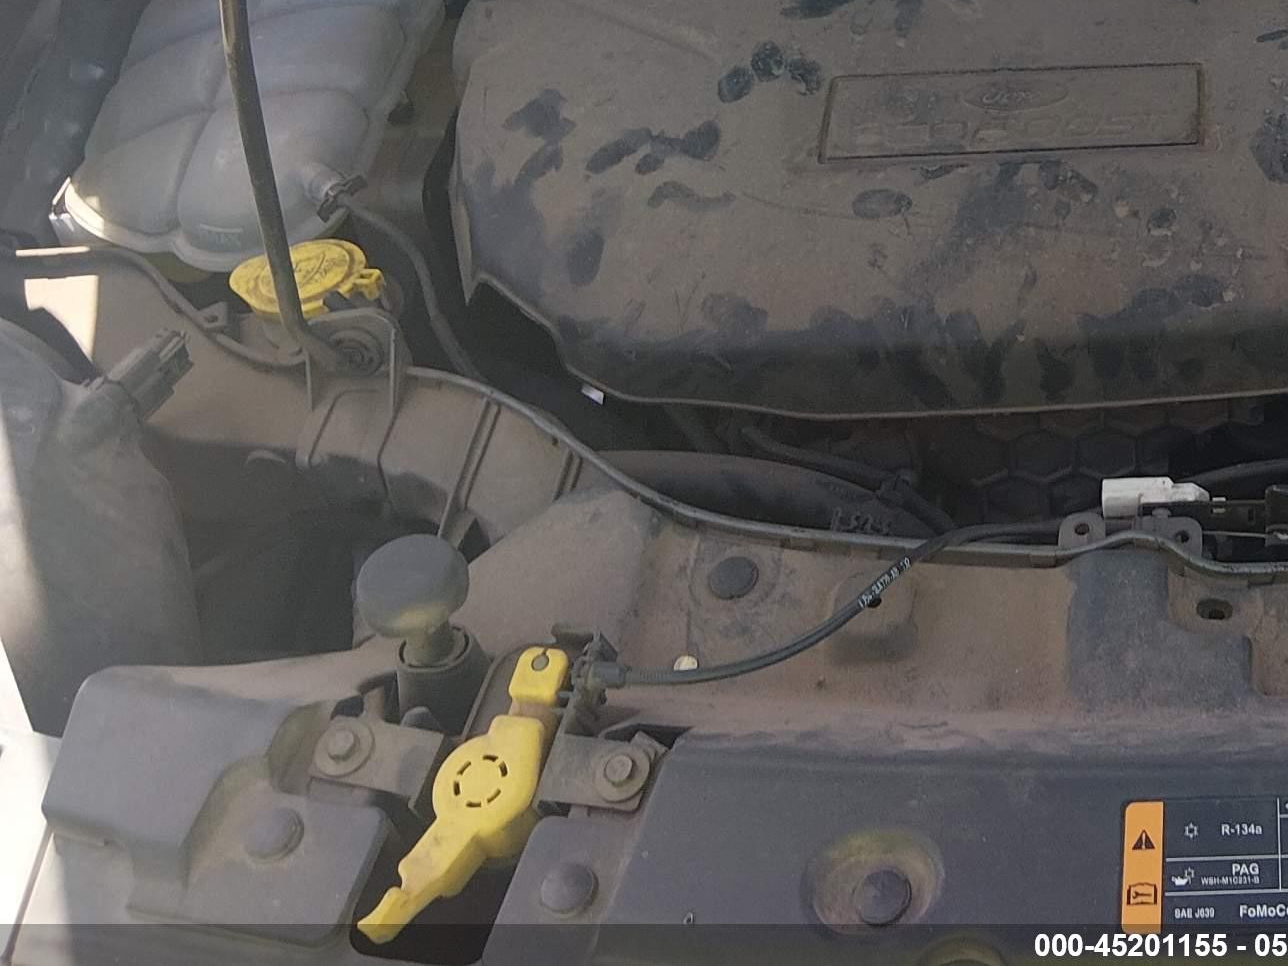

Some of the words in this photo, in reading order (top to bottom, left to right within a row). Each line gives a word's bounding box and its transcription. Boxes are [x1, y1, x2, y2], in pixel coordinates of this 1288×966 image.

[1221, 823, 1262, 836] R-134a
[1231, 863, 1260, 875] PAG
[1174, 908, 1193, 919] SAE
